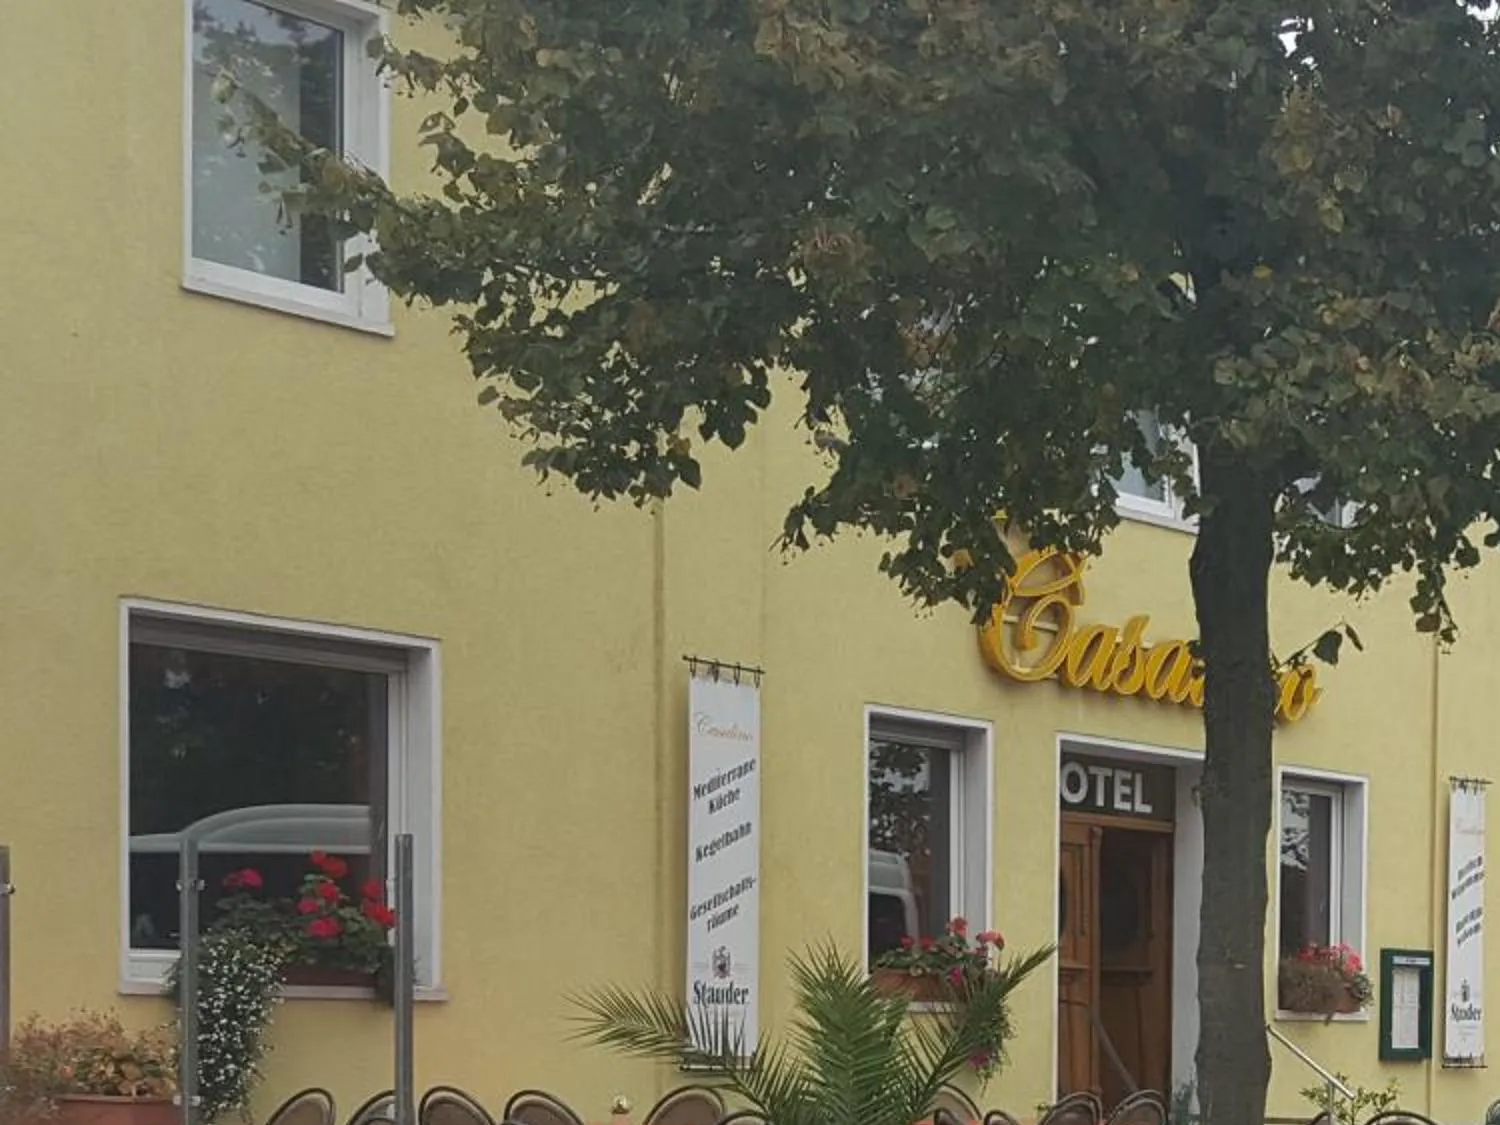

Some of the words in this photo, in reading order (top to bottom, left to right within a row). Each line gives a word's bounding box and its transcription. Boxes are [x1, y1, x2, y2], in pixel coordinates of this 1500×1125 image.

[979, 546, 1322, 723] Casao
[1060, 761, 1152, 813] OTEL
[693, 980, 750, 1008] Stauder
